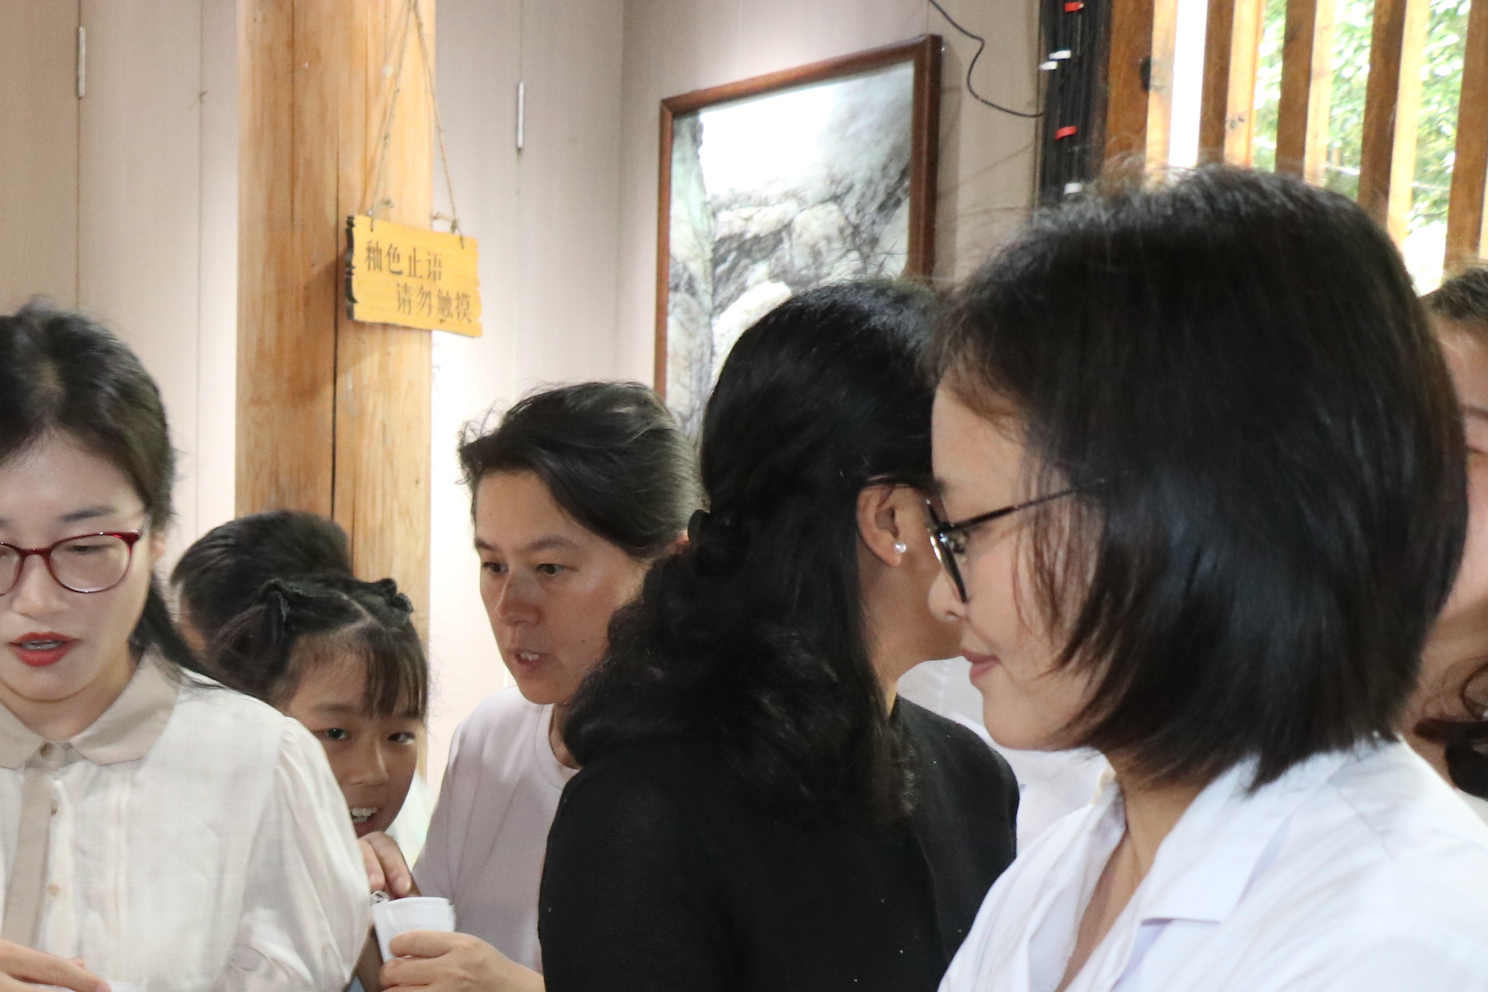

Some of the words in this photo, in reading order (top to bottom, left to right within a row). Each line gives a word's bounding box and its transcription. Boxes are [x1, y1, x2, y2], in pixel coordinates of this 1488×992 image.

[365, 241, 443, 282] 釉色止语
[396, 282, 472, 323] 请勿触摸
